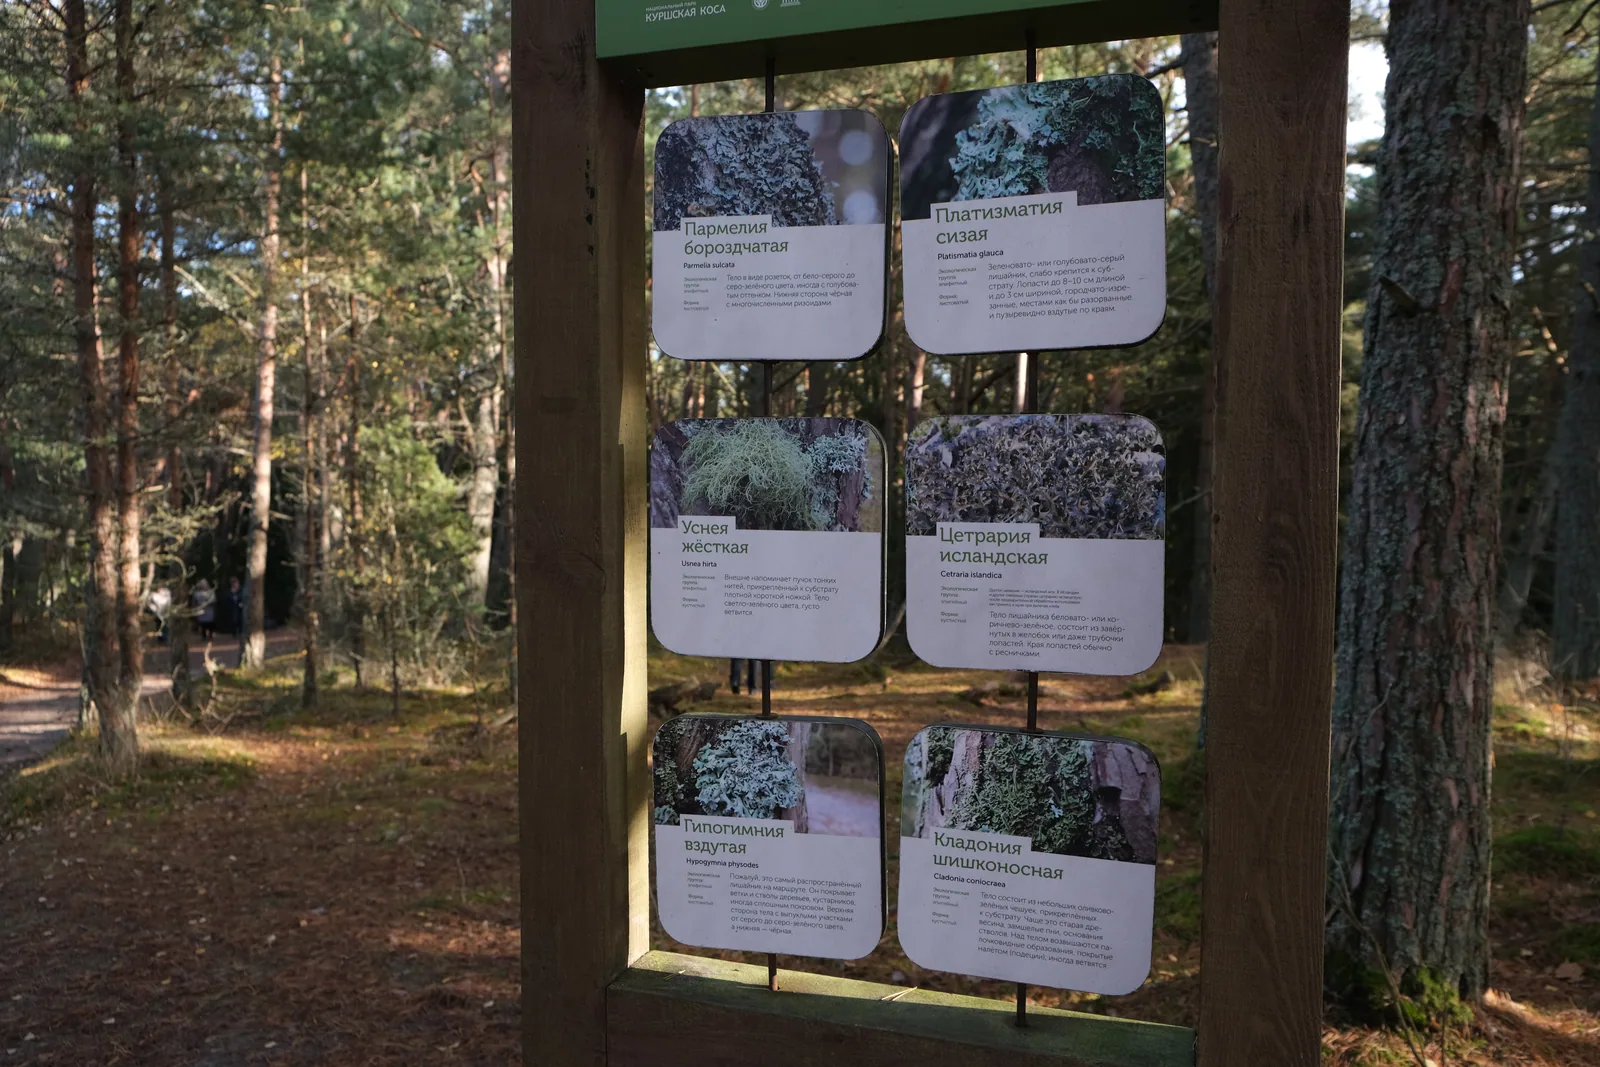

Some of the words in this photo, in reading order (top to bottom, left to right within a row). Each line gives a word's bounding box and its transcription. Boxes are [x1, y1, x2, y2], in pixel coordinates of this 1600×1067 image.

[646, 8, 696, 22] КУРШСКАЯ
[700, 5, 725, 15] КОСА
[936, 202, 1063, 223] Платизматия
[685, 222, 767, 238] Пармелия
[936, 229, 988, 244] сизая
[685, 240, 788, 257] бороздчатая
[938, 251, 977, 260] Platismatia
[979, 250, 1003, 258] glauca
[988, 262, 1035, 270] Зеленовато-
[1053, 254, 1124, 266] голубовато-серый
[989, 272, 1027, 280] лишайник,
[1030, 269, 1052, 277] слабо
[1055, 268, 1089, 276] крепится
[1097, 265, 1114, 274] суб-
[1096, 274, 1125, 283] длиной
[827, 281, 859, 289] голубова-
[1026, 288, 1063, 298] шириной,
[1065, 285, 1130, 295] городчато-изре-
[1081, 295, 1132, 304] разорванные
[996, 310, 1046, 320] пузыревидно
[1048, 308, 1077, 316] вздутые
[682, 520, 728, 534] Уснея
[940, 527, 1030, 546] Цетрария
[682, 539, 748, 553] жёсткая
[940, 551, 1048, 566] исландская
[805, 585, 839, 594] субстрату
[1051, 613, 1089, 621] беловато-
[989, 622, 1055, 630] ричнево-зелёное,
[1101, 625, 1125, 633] завёр-
[684, 819, 784, 838] Гипогимния
[685, 841, 746, 855] вздутая
[935, 832, 1022, 855] Кладония
[686, 858, 726, 866] Hypogymnia
[933, 855, 1063, 879] шишконосная
[730, 873, 760, 882] Пожалуй,
[797, 879, 861, 888] распространённый
[934, 873, 964, 882] Cladonia
[966, 878, 1005, 887] coniocraea
[981, 892, 996, 900] Тело
[1038, 900, 1076, 910] небольших
[1078, 906, 1114, 914] оливково-
[781, 912, 817, 920] выпуклыми
[980, 902, 1008, 910] зелёных
[1010, 906, 1037, 914] чешуек,
[1040, 910, 1097, 921] прикреплённых
[1024, 916, 1043, 924] Чаще
[1059, 921, 1083, 929] старая
[1008, 924, 1044, 933] замшелые
[1063, 931, 1103, 940] основания
[1011, 932, 1025, 940] Над
[1050, 938, 1099, 949] возвышаются
[979, 937, 1025, 948] почковидные
[1077, 951, 1113, 960] покрытые
[1049, 956, 1073, 964] иногда
